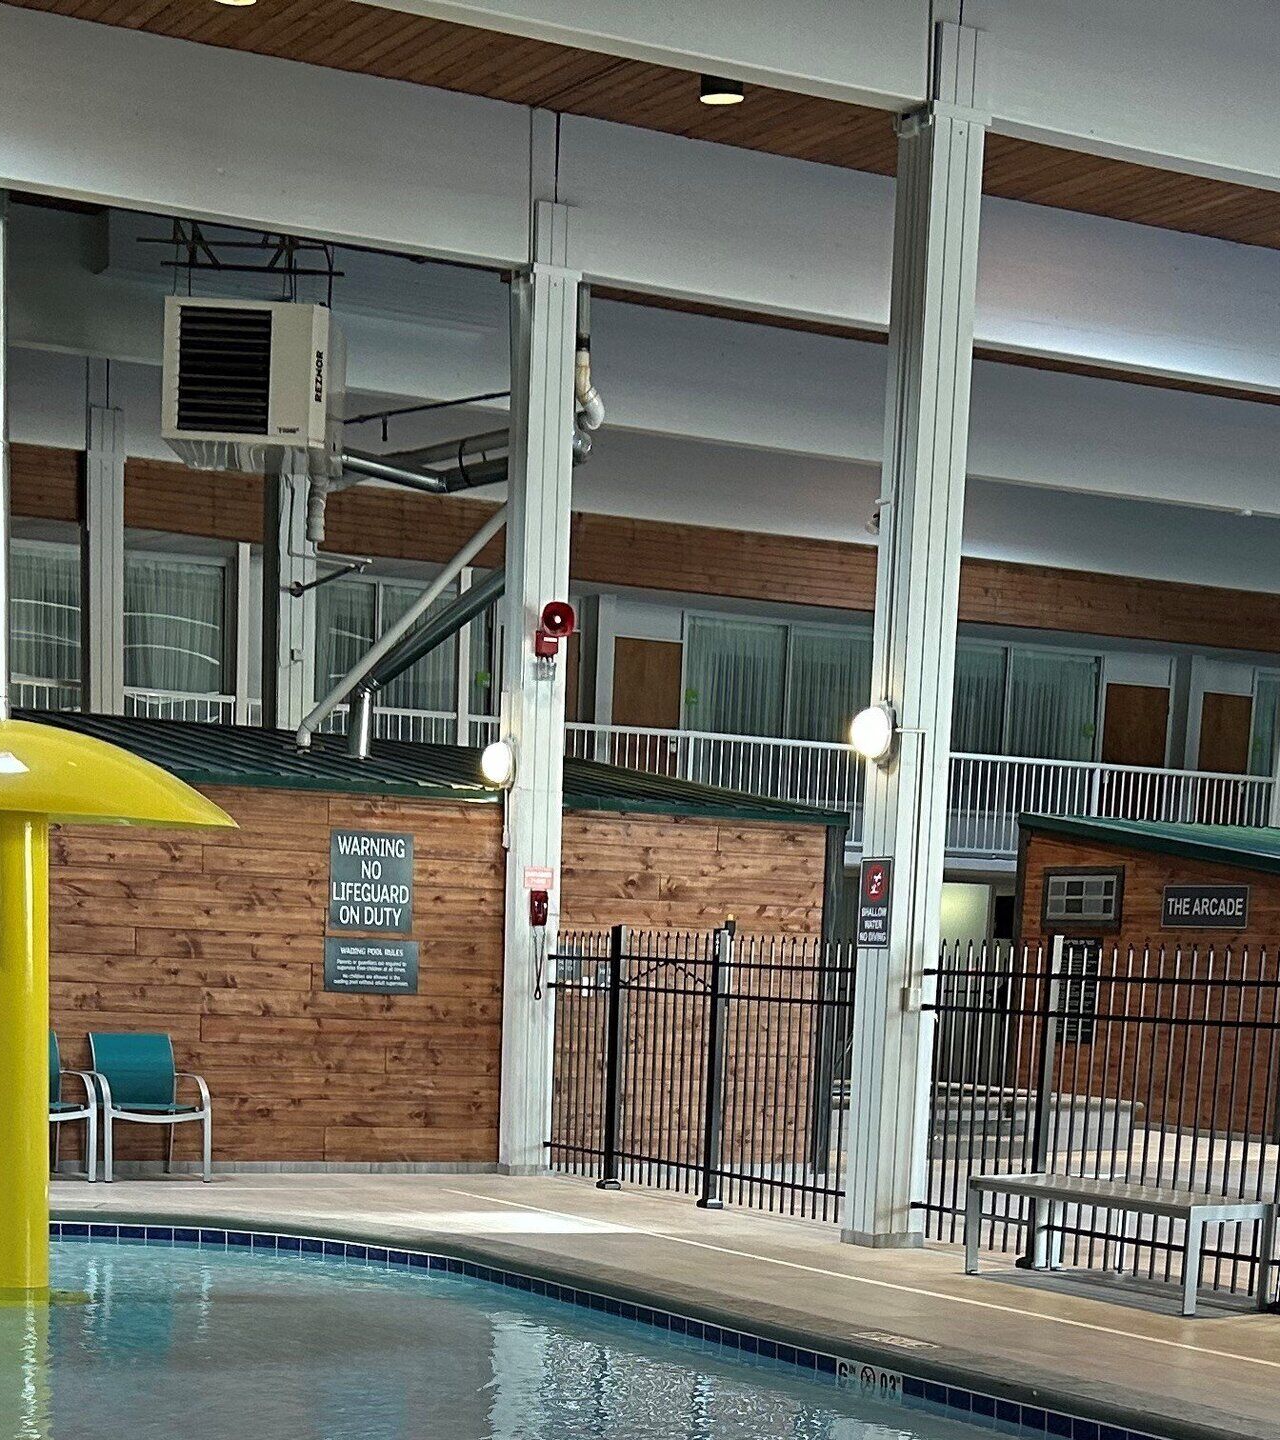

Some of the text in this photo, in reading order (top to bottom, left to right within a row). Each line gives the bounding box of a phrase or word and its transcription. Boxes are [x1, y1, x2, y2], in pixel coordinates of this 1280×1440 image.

[337, 834, 405, 858] WARNING
[360, 860, 382, 880] NO
[332, 881, 410, 905] LIFEGUARD
[339, 905, 402, 927] ON DUTY
[1167, 897, 1244, 916] THE ARCADE
[339, 946, 366, 955] WADING
[367, 947, 383, 956] POOL
